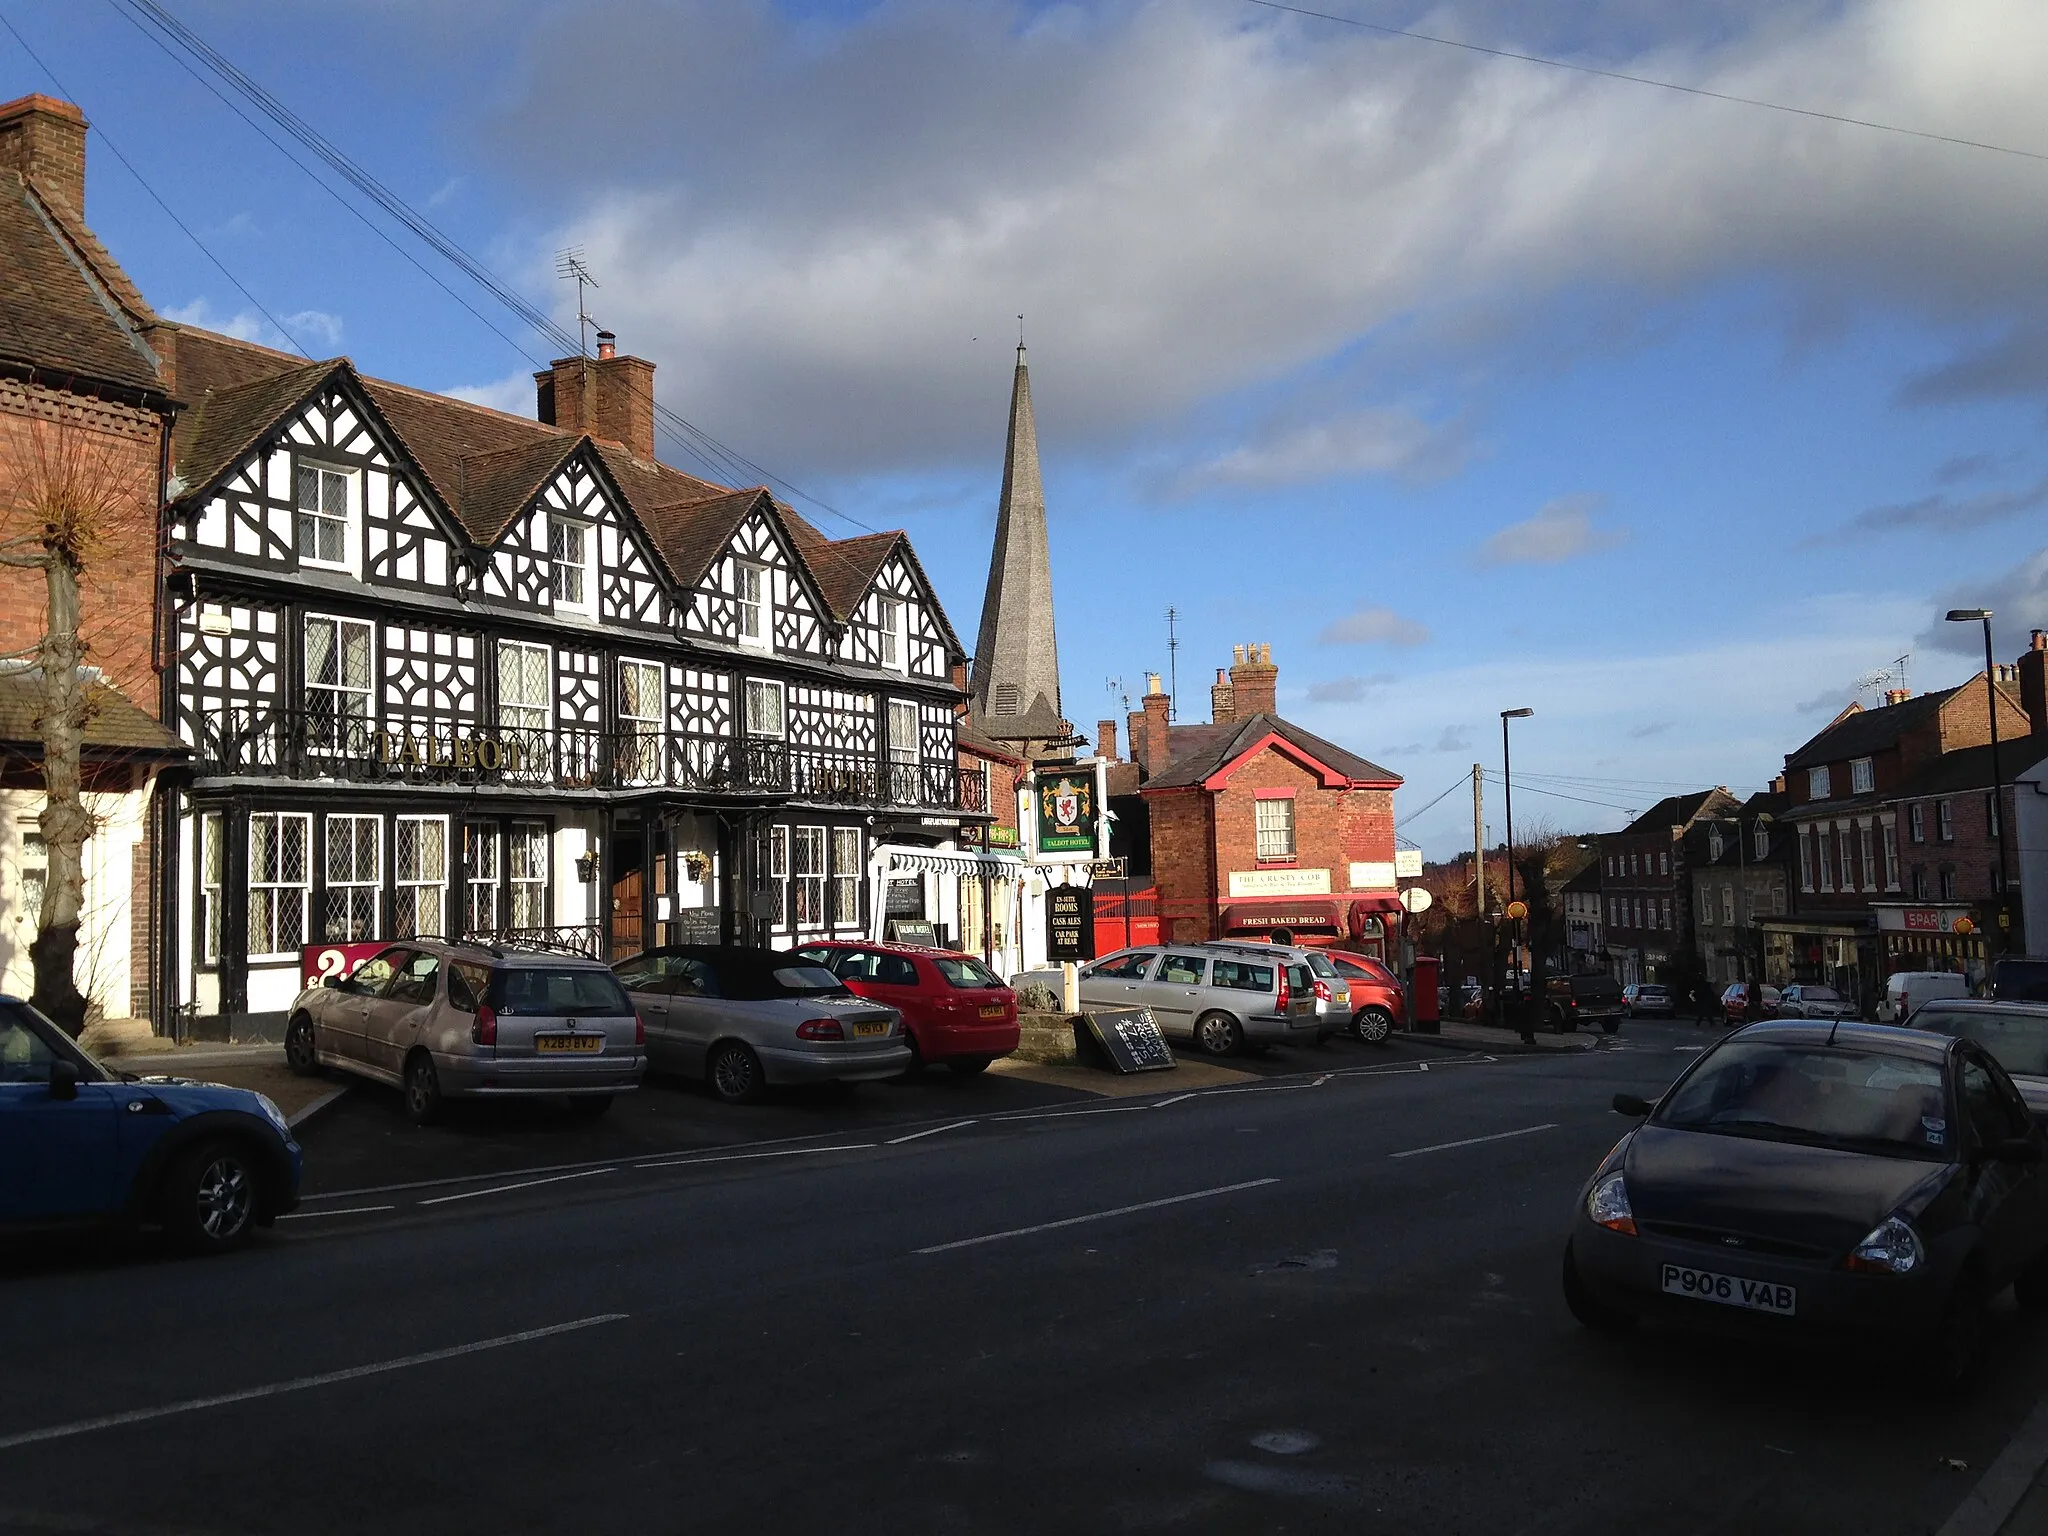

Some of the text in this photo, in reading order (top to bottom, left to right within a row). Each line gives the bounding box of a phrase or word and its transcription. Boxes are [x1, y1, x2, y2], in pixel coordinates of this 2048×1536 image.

[373, 731, 525, 771] TALBOT
[815, 767, 885, 795] HOTEL
[1047, 838, 1089, 847] TALBOT HOTEL
[1260, 874, 1296, 882] CRUSTY
[1055, 903, 1078, 912] ROOMS
[1053, 917, 1081, 925] CASK ALES
[1909, 912, 1938, 926] SPAR
[1145, 1011, 1160, 1036] TALBOT
[543, 1037, 594, 1048] X283 BVJ
[1135, 1022, 1160, 1060] ROAST
[1137, 1013, 1167, 1060] SUNDAY
[1664, 1266, 1792, 1309] P906 VAB
